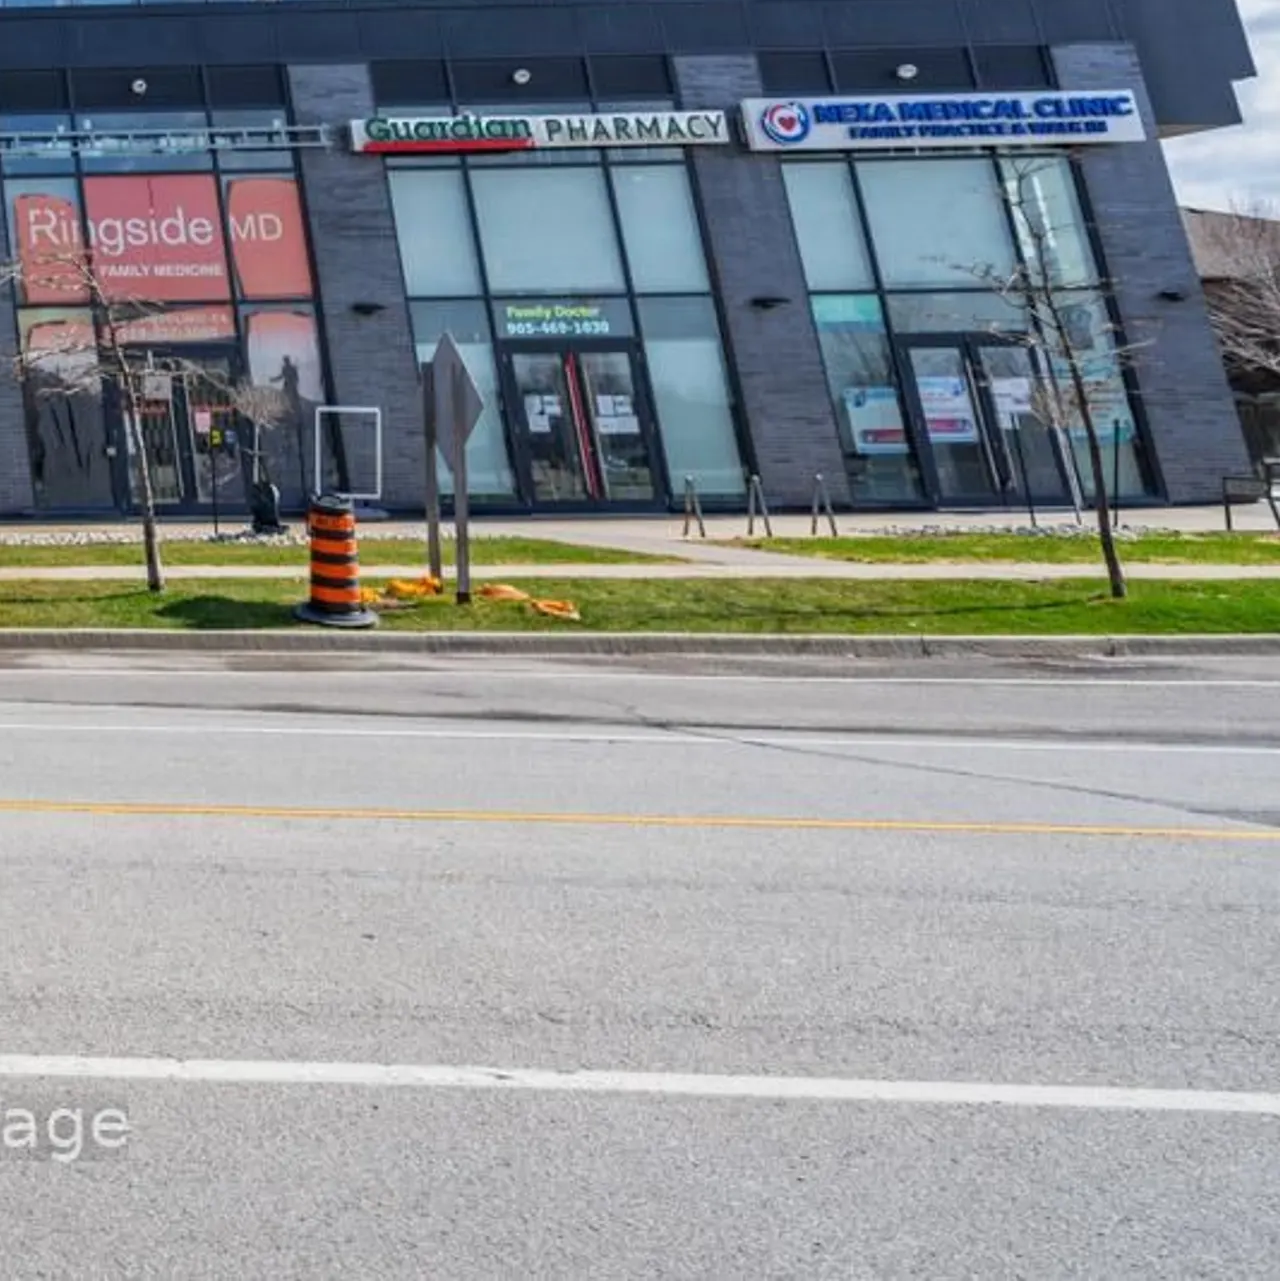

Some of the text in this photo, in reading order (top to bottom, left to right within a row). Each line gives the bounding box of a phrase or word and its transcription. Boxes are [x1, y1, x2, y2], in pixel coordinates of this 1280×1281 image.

[897, 100, 1030, 122] MEDICAL
[1034, 96, 1132, 118] CLINIC
[364, 114, 722, 141] Guardian PHARMACY
[28, 206, 283, 257] Ringside MD
[100, 263, 224, 278] FAMILY MEDICINE
[506, 306, 552, 320] Family
